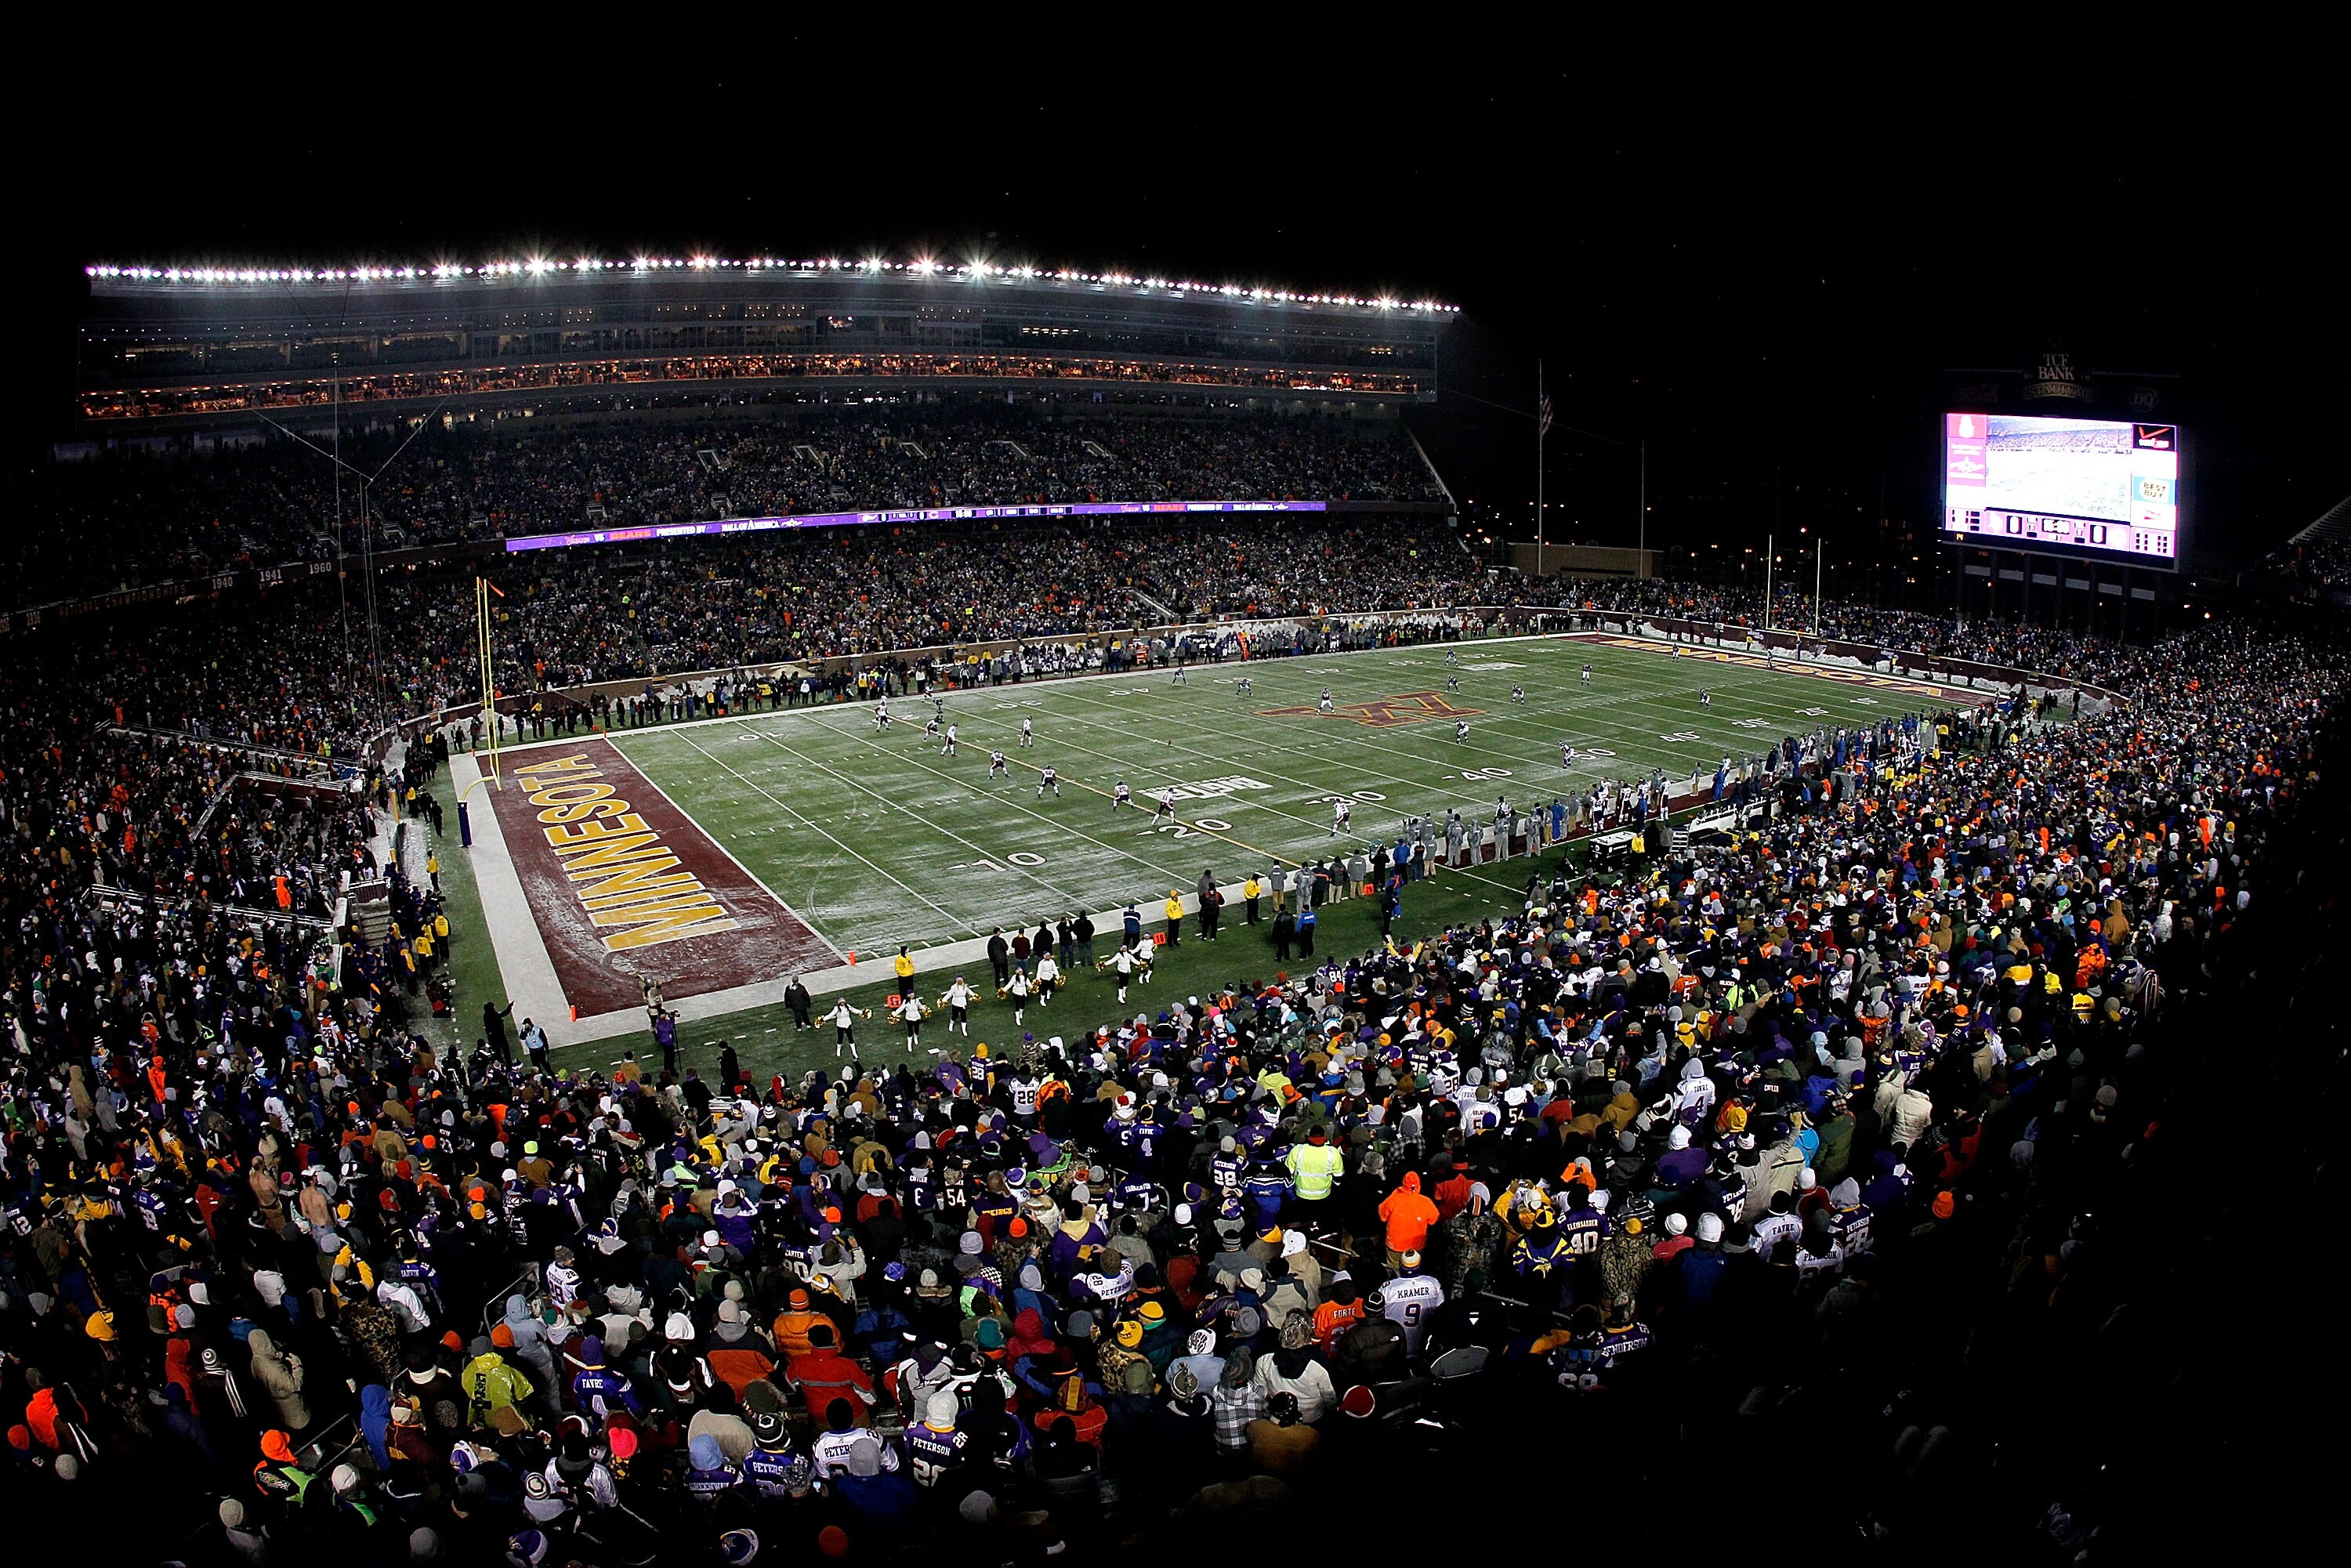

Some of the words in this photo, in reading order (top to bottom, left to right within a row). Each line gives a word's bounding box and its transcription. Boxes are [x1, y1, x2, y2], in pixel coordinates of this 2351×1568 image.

[2042, 353, 2069, 366] TCF
[2038, 367, 2075, 381] BANK
[2024, 382, 2095, 401] STADIUM
[2143, 482, 2166, 492] BEST
[2143, 489, 2164, 498] BUY
[610, 529, 652, 540] BEARS
[656, 526, 696, 537] PRESENTED
[697, 525, 707, 534] BY
[259, 569, 282, 581] 1941
[309, 562, 331, 574] 1960
[212, 576, 234, 589] 1940
[1459, 766, 1515, 781] 40
[1157, 817, 1233, 840] 20
[513, 753, 741, 952] MINNESOTA
[971, 851, 1047, 872] 10
[972, 1066, 985, 1081] 28
[1694, 1084, 1708, 1092] FAVRE
[1018, 1090, 1036, 1104] 28
[1695, 1096, 1704, 1112] 4
[1509, 1108, 1525, 1124] 54
[1141, 1138, 1153, 1157] 4
[1214, 1160, 1237, 1170] PETERSON
[909, 1175, 928, 1183] CUTLER
[1214, 1169, 1237, 1186] 28
[946, 1188, 966, 1208] 54
[11, 1215, 32, 1237] 12
[1772, 1223, 1795, 1235] FAVRE
[1846, 1216, 1870, 1233] PETERSON
[1570, 1231, 1599, 1255] 40
[1845, 1226, 1870, 1258] 28
[785, 1249, 804, 1259] CARTER
[1804, 1250, 1837, 1262] PESON
[565, 1270, 576, 1280] 28
[1092, 1275, 1103, 1286] 28
[1100, 1280, 1132, 1297] PETERSON
[1397, 1287, 1429, 1299] KRAMER
[1334, 1307, 1356, 1320] FORTE
[1403, 1303, 1422, 1327] 9
[582, 1378, 603, 1389] FAVRE
[592, 1395, 609, 1421] 4
[824, 1443, 853, 1459] PETERS
[912, 1436, 951, 1457] PETERSON
[752, 1461, 784, 1474] PETERS
[689, 1481, 730, 1491] GREENWAY
